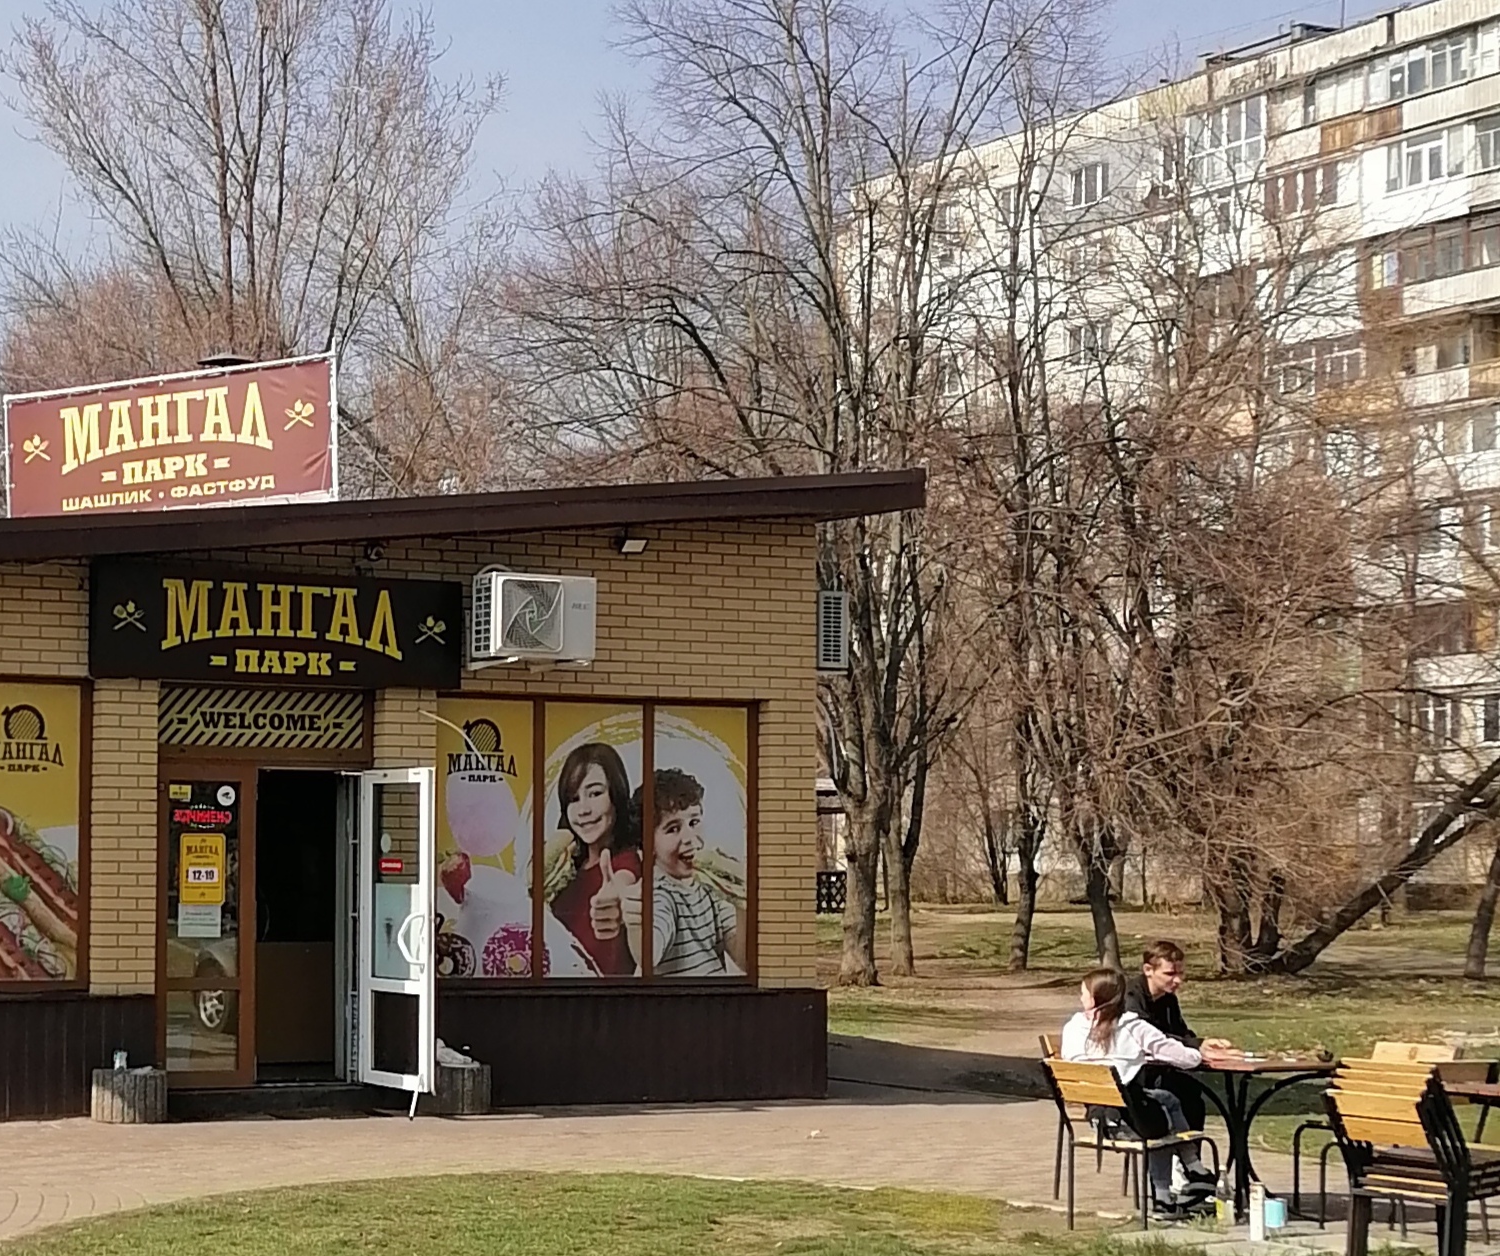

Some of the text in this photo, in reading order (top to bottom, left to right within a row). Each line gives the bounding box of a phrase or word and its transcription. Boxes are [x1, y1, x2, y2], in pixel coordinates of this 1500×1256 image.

[59, 381, 273, 476] МАНГАЛ
[122, 453, 208, 486] ПАРК
[62, 475, 276, 512] ШАШЛИК ФАСТФУД
[161, 578, 403, 661] МАНГАЛ
[235, 649, 332, 676] ПАРК
[200, 710, 323, 733] WELCOME
[7, 764, 40, 773] ПАРК
[447, 752, 518, 778] МАНГАЛ
